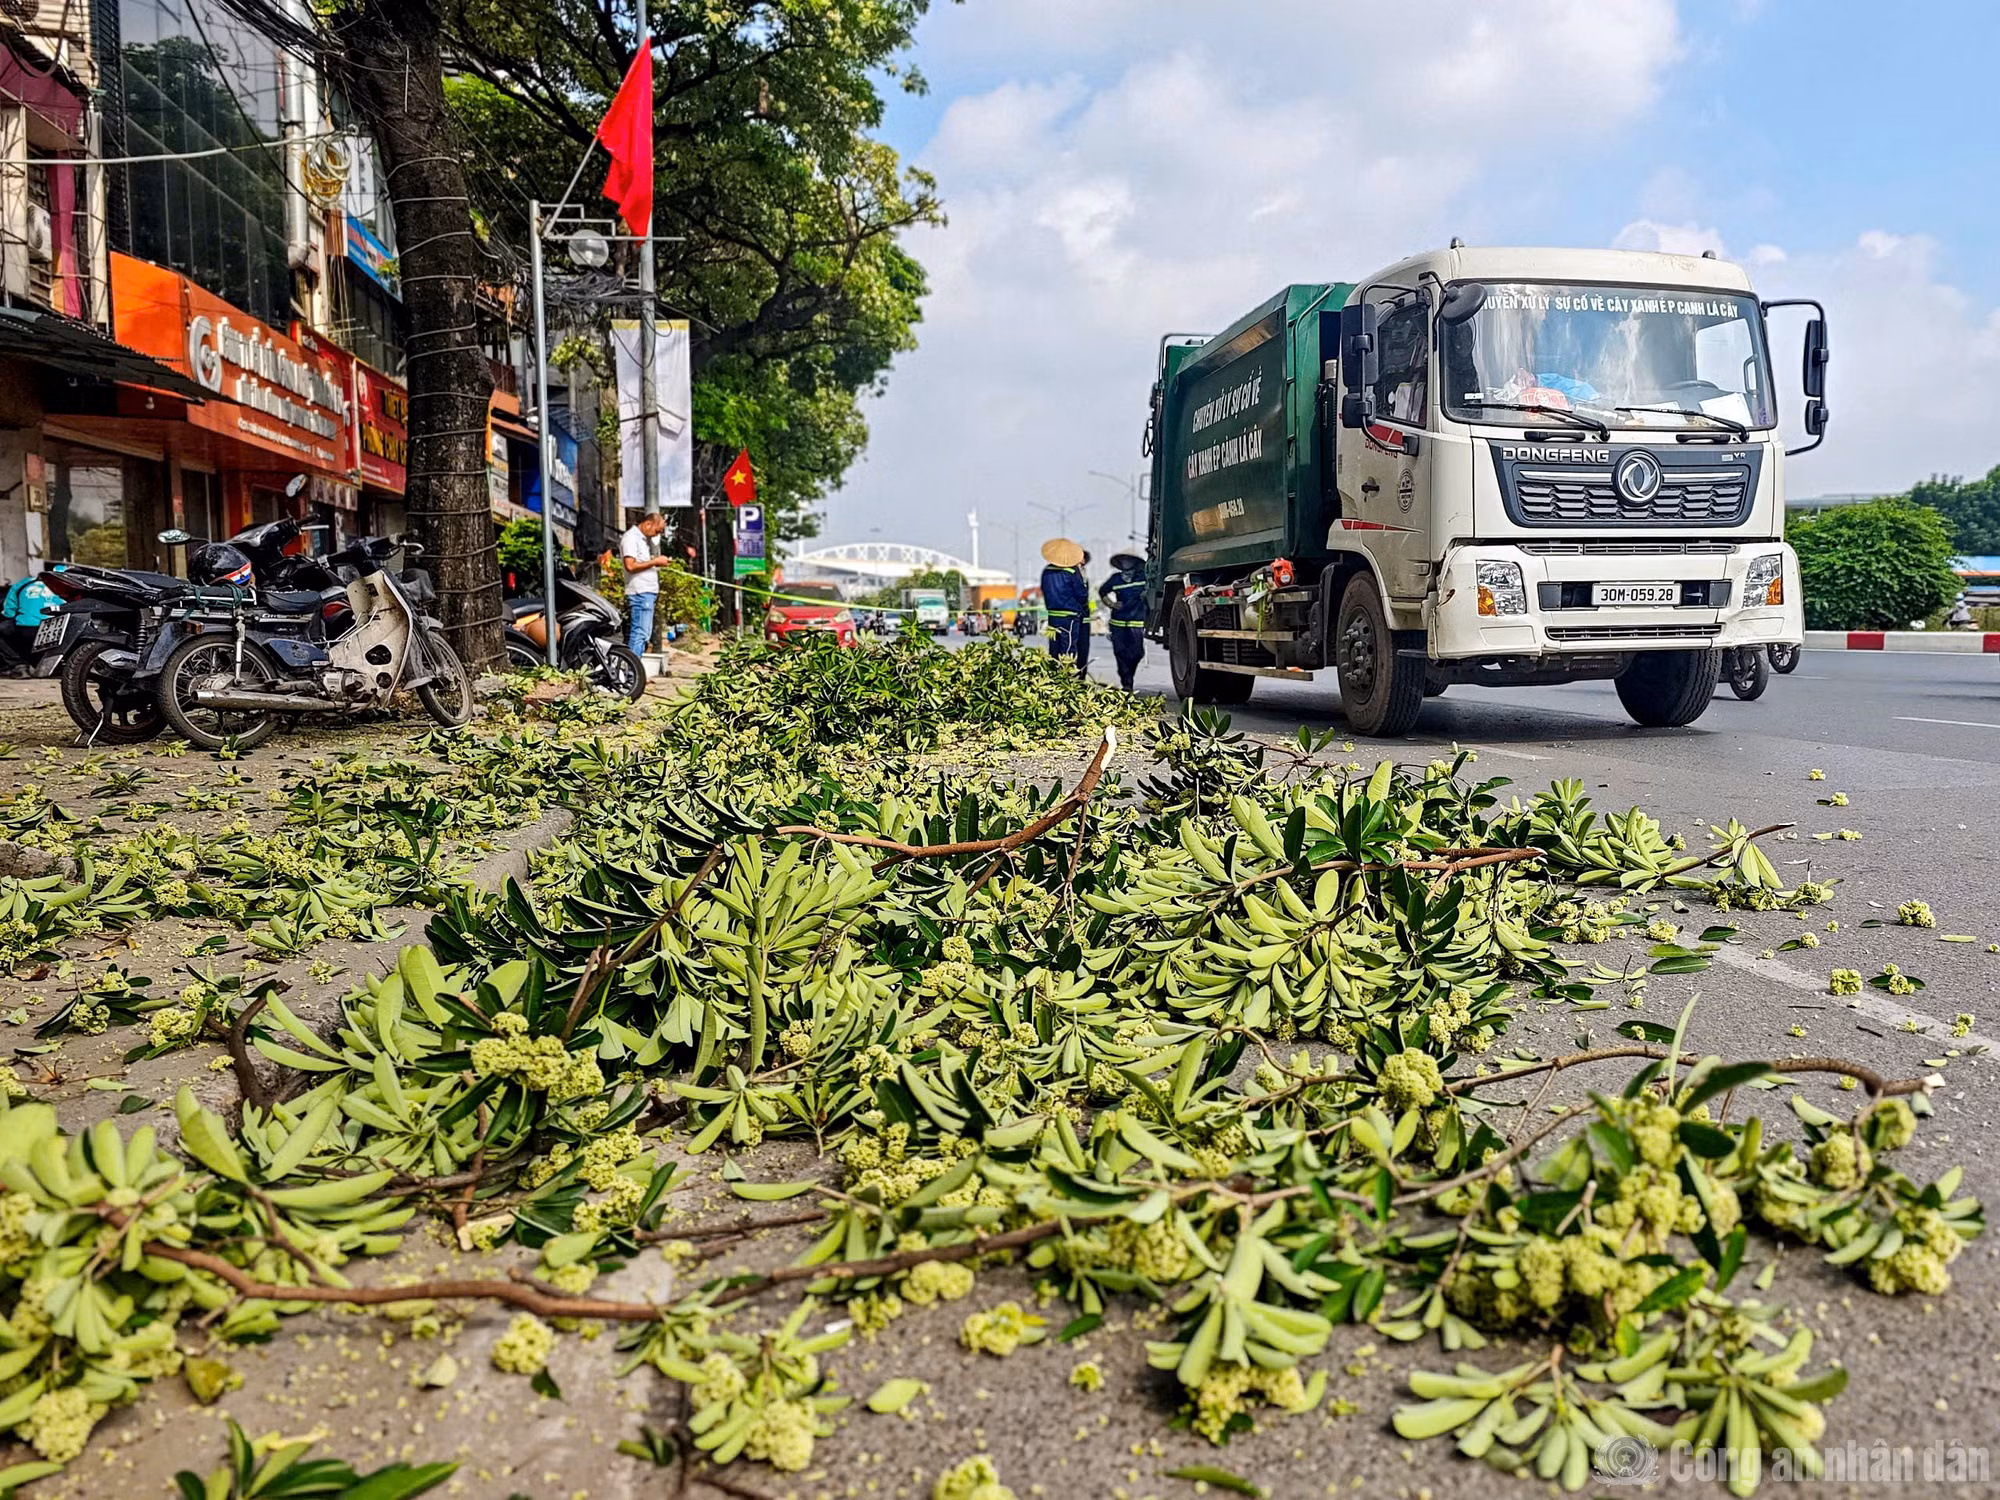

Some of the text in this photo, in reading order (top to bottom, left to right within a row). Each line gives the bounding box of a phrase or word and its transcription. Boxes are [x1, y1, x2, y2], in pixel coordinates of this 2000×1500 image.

[1538, 293, 1550, 310] LÝ
[1573, 293, 1589, 311] CỐ
[1606, 296, 1628, 313] CÂY
[1630, 299, 1660, 313] XANH
[1706, 300, 1720, 317] LÁ
[1720, 302, 1738, 318] CÂY
[1248, 424, 1263, 460] CÂY
[1502, 447, 1609, 463] DONGFENG
[740, 507, 760, 530] P
[1601, 589, 1673, 601] 30M-059.28
